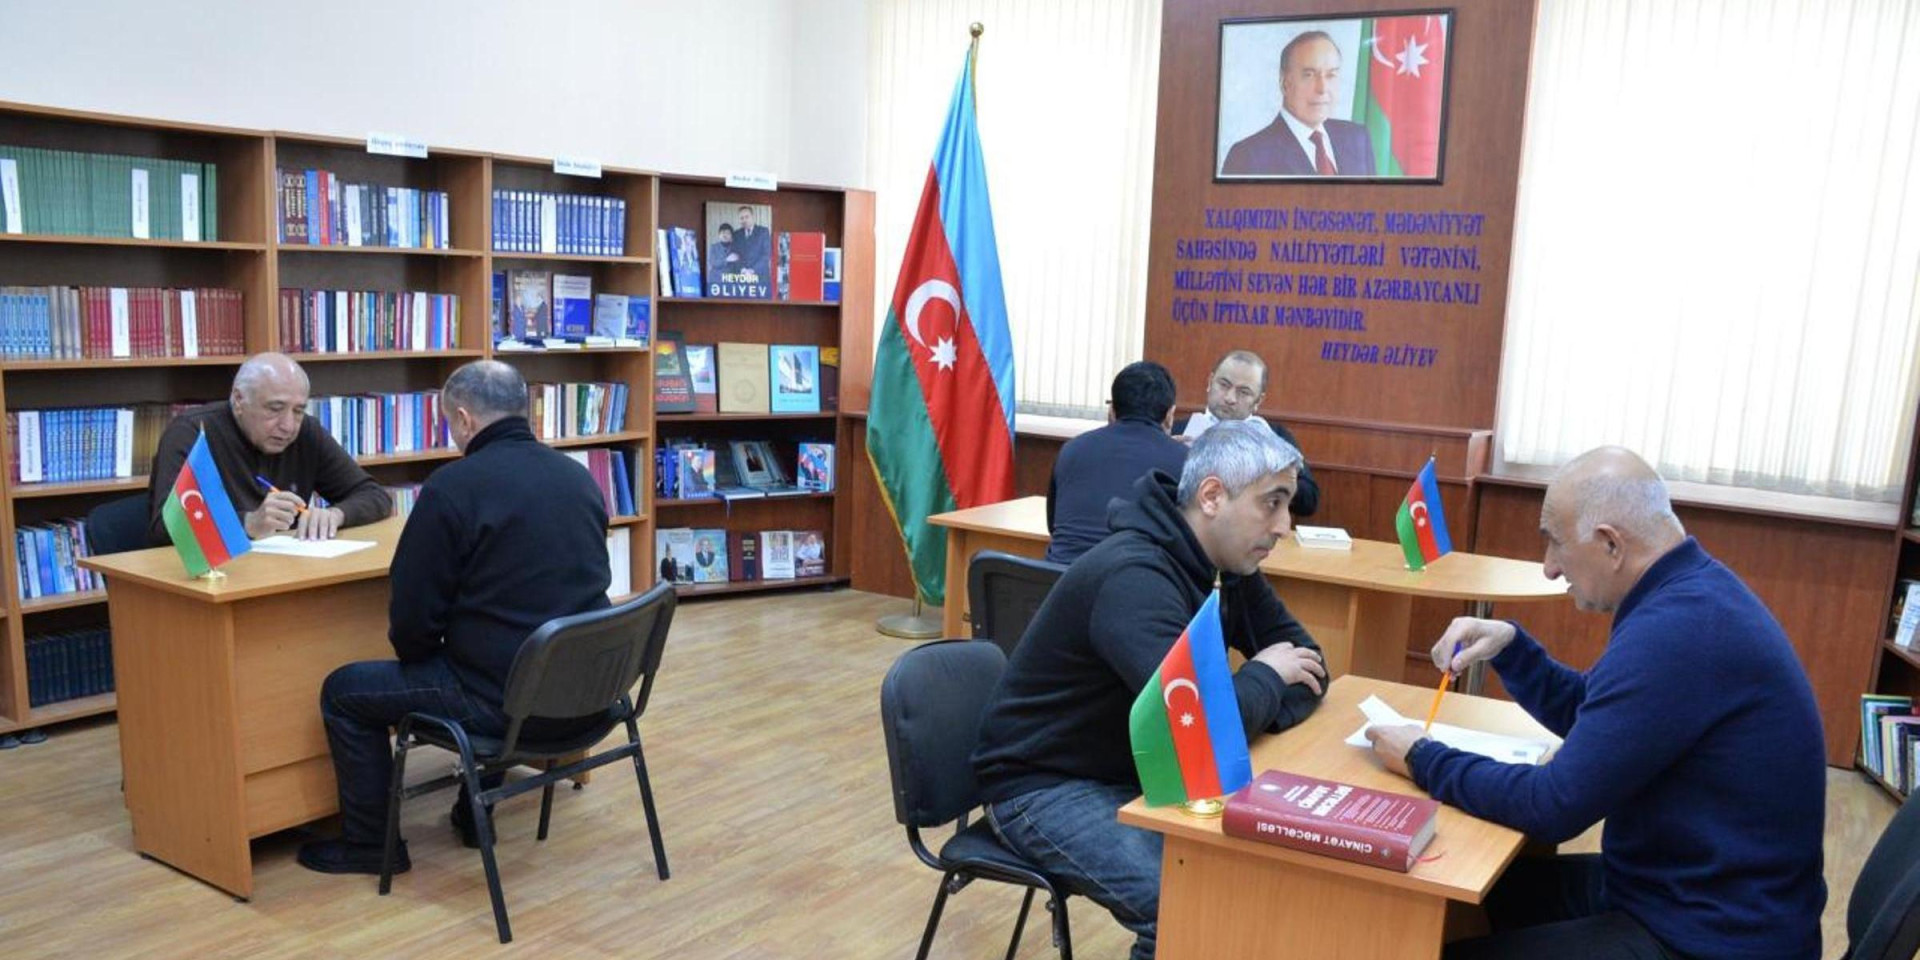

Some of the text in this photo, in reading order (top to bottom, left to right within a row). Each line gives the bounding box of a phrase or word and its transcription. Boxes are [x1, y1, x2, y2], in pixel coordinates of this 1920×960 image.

[1204, 207, 1289, 231] XALQIMIZIN
[1384, 209, 1486, 237] MƏDƏNİYYƏT
[1175, 237, 1481, 271] SAHƏSİNDƏ NAİLİYYƏTLƏRİ VƏTƏNİNİ,
[1173, 268, 1480, 305] MİLLƏTİNİ SEVƏN HƏR BİR AZƏRBAYCANLI
[1172, 297, 1367, 332] ÜÇÜN İFTİXAR MƏNBƏYİDİR.
[1321, 341, 1438, 368] HEYDƏR ƏLİYEV
[1256, 821, 1372, 854] CİNAYƏT MƏCƏLLƏSİ
